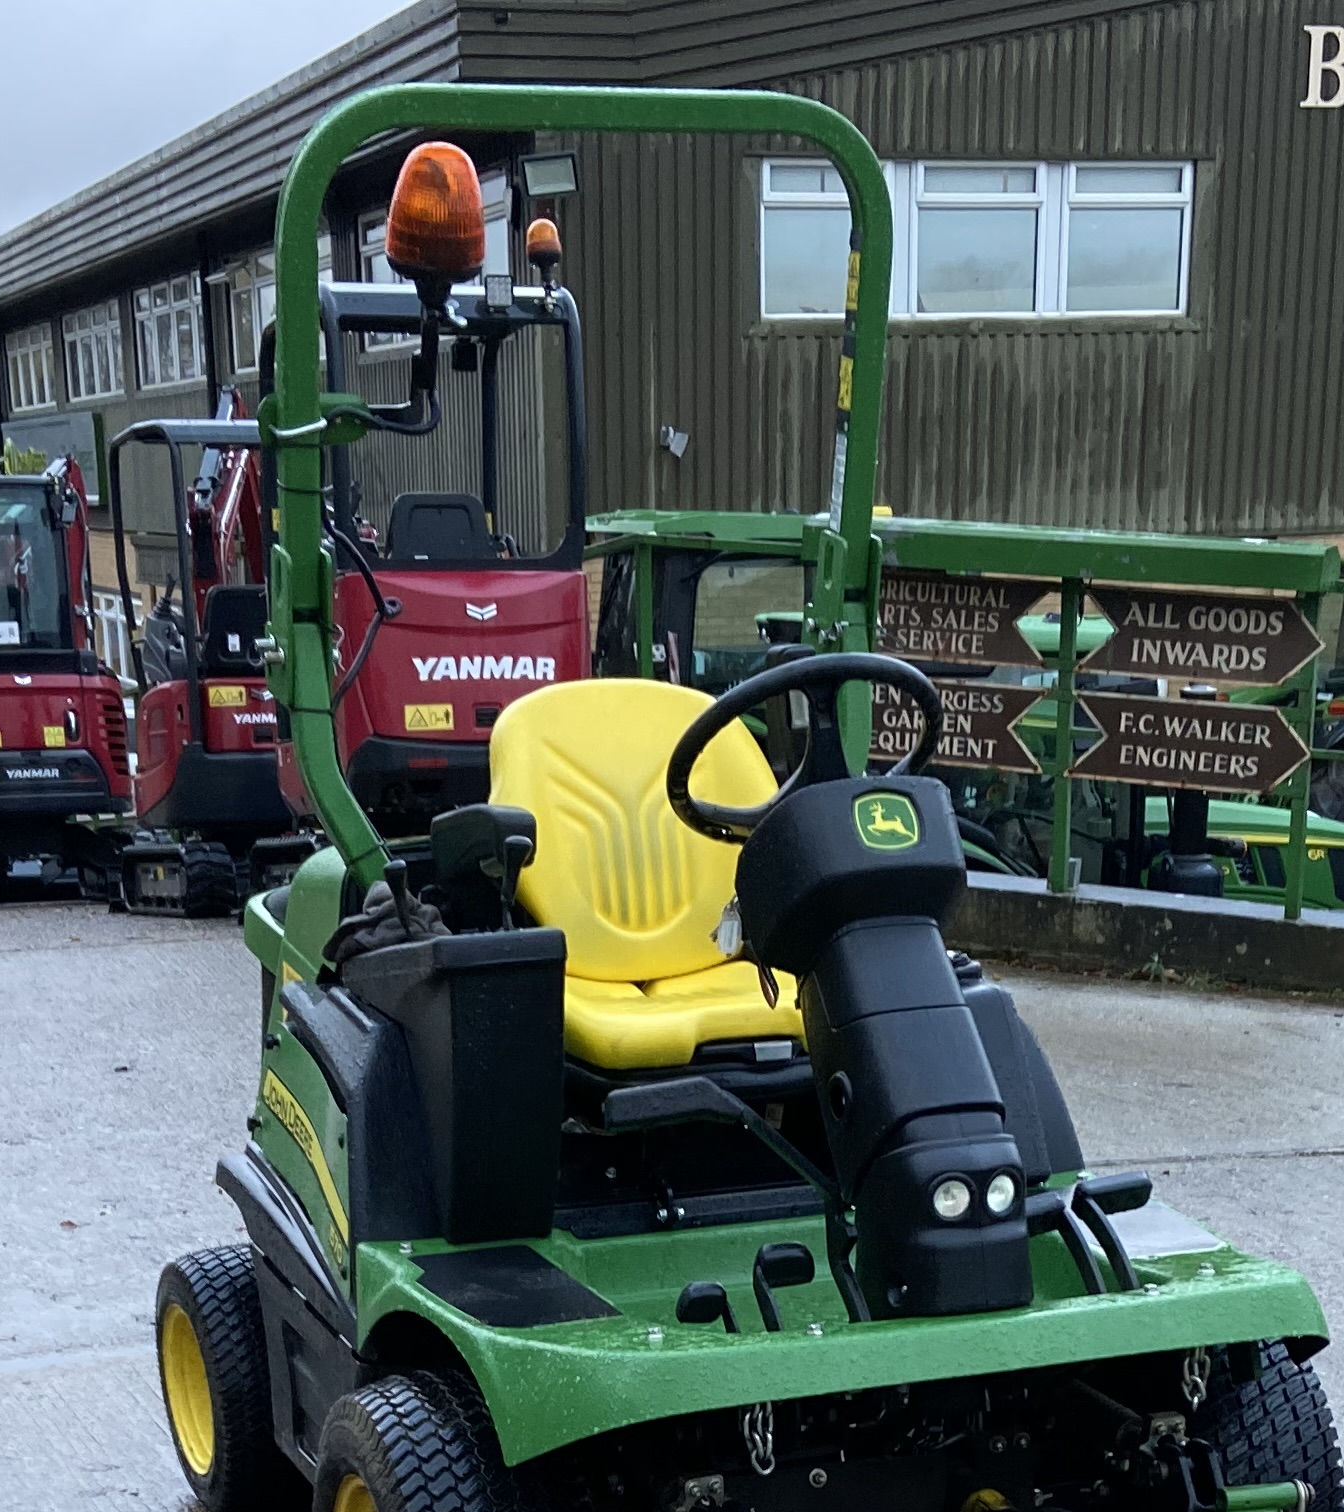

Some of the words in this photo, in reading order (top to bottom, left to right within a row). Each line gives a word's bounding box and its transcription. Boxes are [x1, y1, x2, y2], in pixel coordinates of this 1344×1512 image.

[931, 607, 1000, 633] SALES
[1123, 601, 1180, 630] ALL
[1188, 605, 1285, 637] GOODS
[896, 628, 985, 655] SERVICE
[412, 655, 556, 682] YANMAR
[1131, 638, 1268, 673] INWARDS
[883, 708, 972, 734] GAREN
[6, 768, 60, 780] YANMAR
[1119, 744, 1260, 779] ENGINEERS
